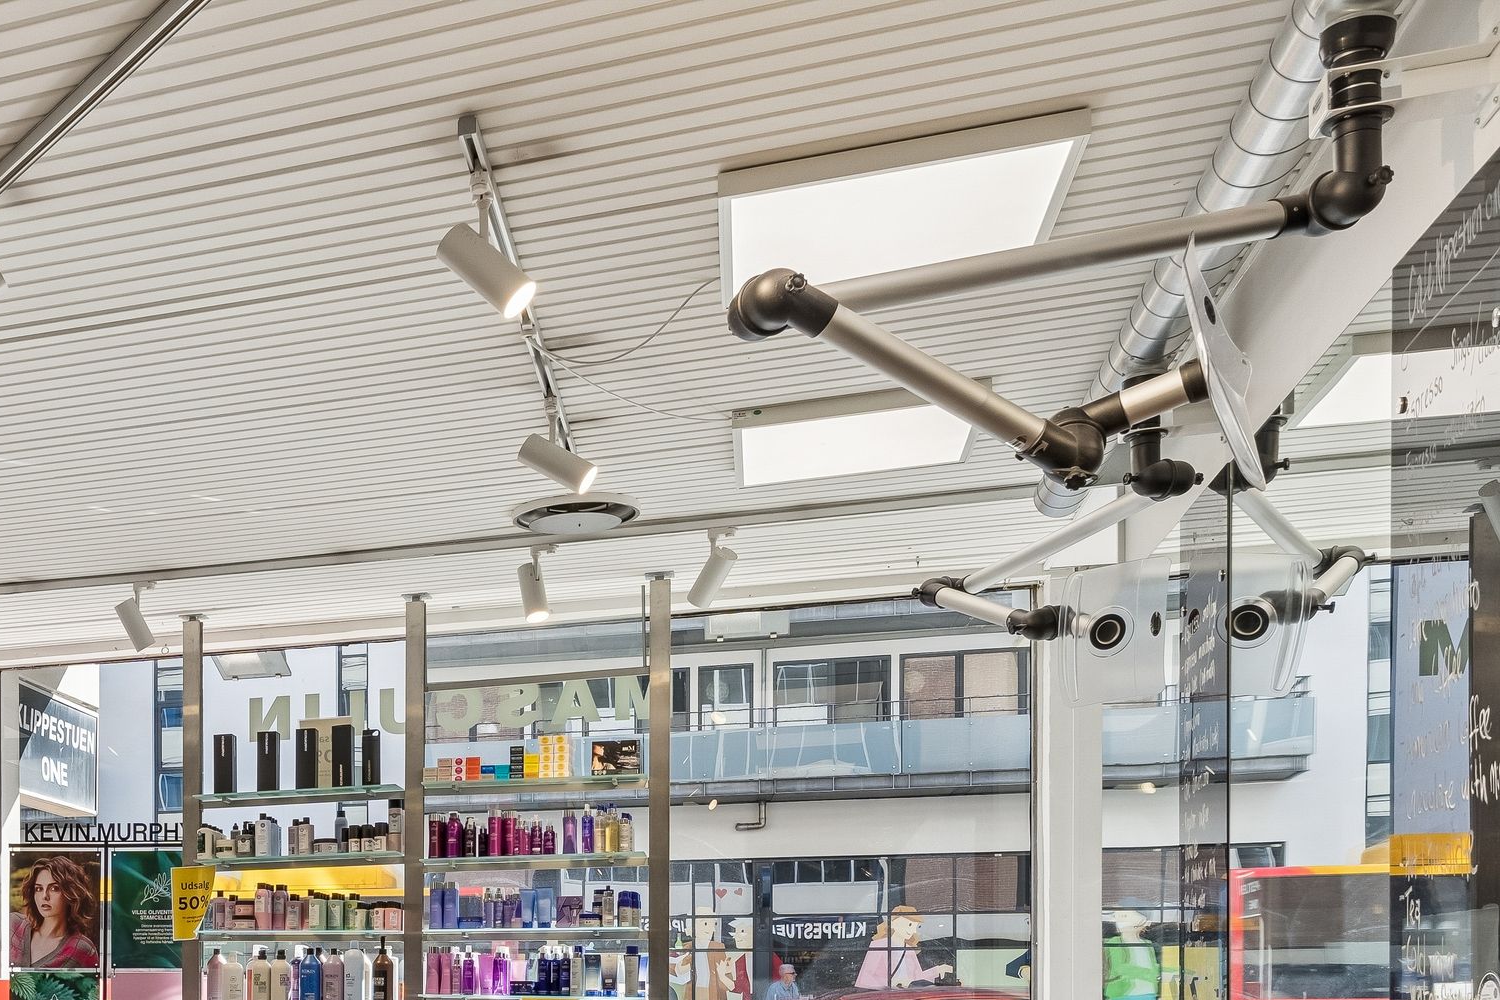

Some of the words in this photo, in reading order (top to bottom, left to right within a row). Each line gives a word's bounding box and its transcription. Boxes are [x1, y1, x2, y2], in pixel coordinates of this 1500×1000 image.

[19, 703, 95, 755] KLIPPESTUEN
[41, 756, 69, 787] ONE
[181, 880, 210, 891] Udsalg
[178, 894, 209, 911] 50%
